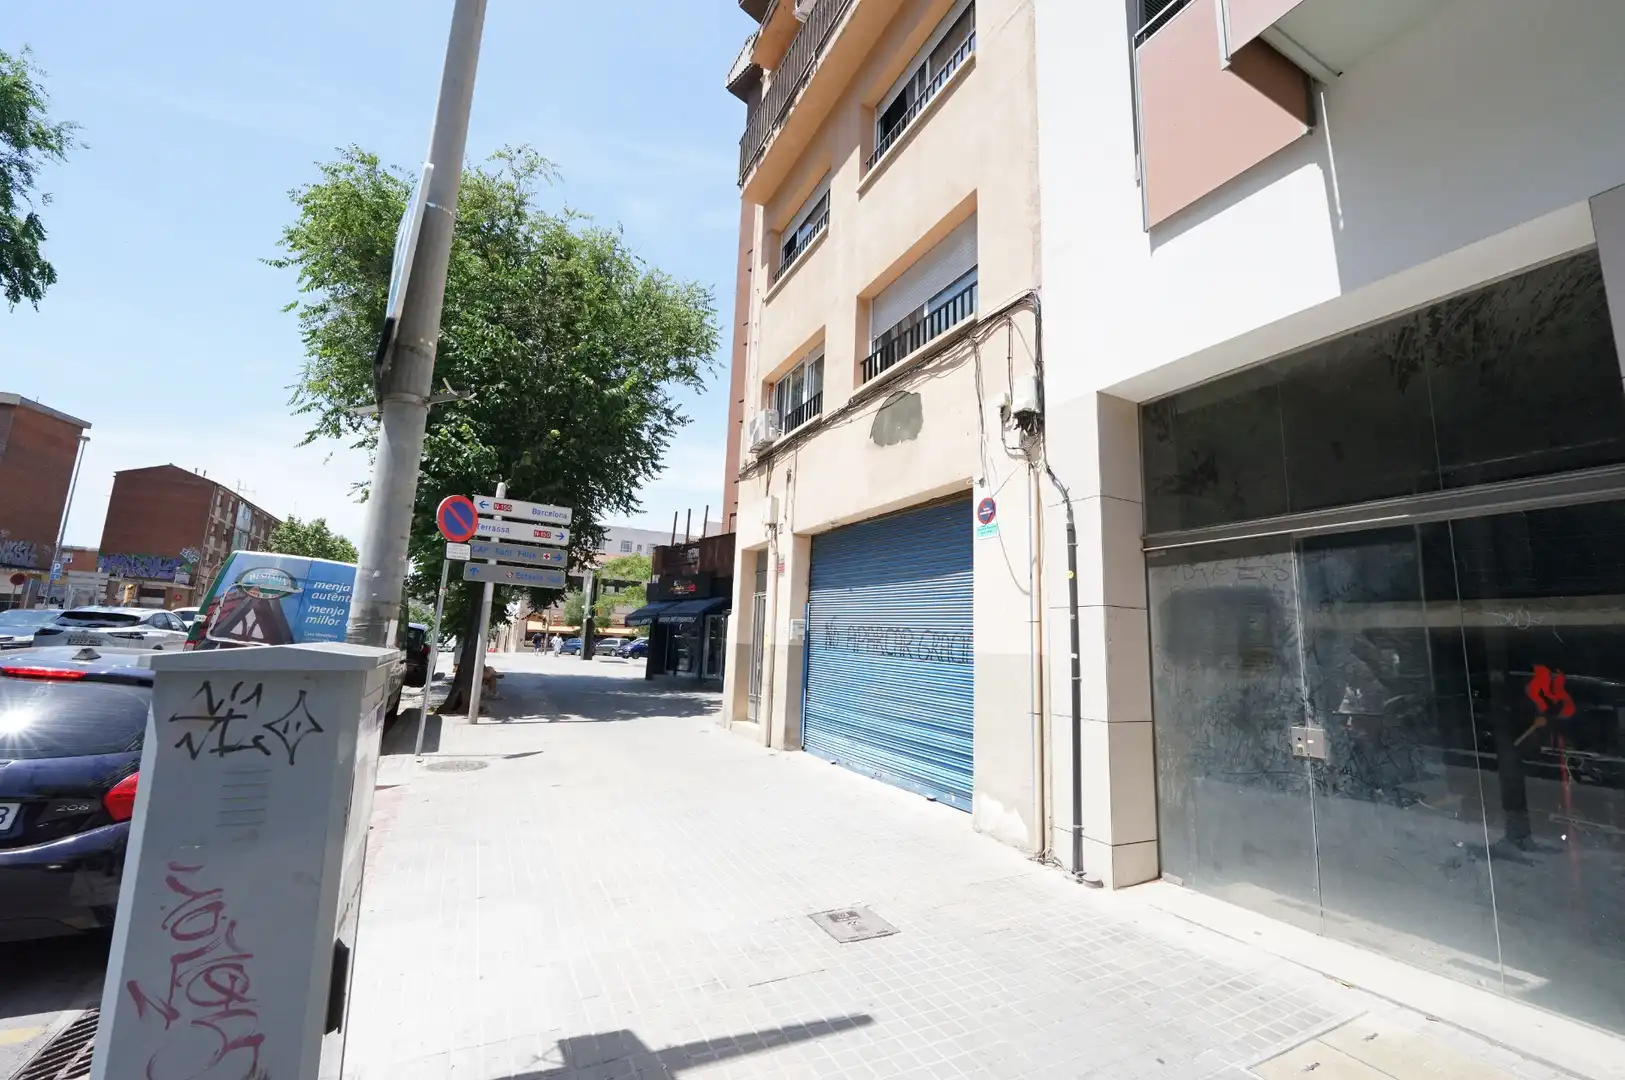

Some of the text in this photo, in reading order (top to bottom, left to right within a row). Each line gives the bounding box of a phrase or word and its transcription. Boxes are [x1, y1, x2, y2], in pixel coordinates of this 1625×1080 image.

[532, 507, 568, 519] Barcelona
[313, 581, 351, 593] menja
[307, 605, 345, 617] menja
[304, 616, 341, 626] millor
[55, 803, 90, 812] 208
